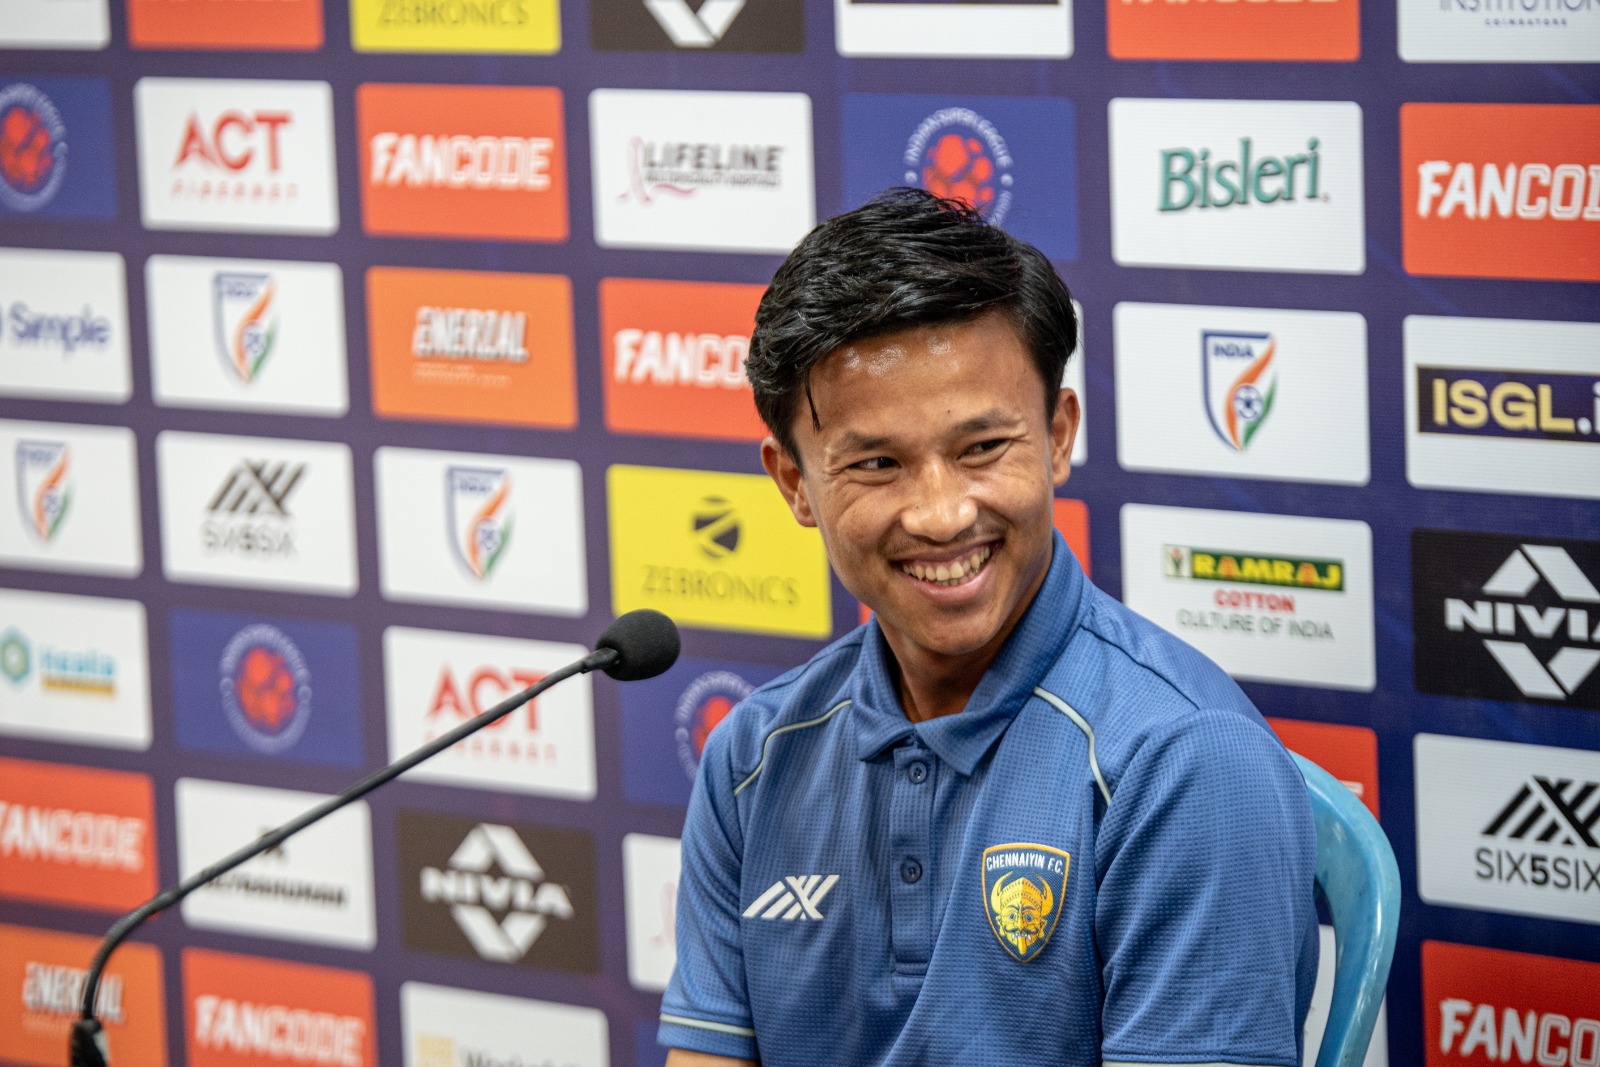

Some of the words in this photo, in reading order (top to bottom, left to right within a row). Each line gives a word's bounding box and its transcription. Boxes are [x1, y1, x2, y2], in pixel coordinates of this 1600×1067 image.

[173, 109, 292, 172] ACT
[370, 132, 553, 190] FANCODE
[614, 328, 752, 388] FANCO
[1213, 341, 1254, 359] INDIA
[640, 564, 802, 607] ZEBRONICS
[1195, 554, 1342, 590] RAMRAJ
[1177, 607, 1253, 633] CULTURE
[1262, 616, 1285, 635] OF
[1289, 619, 1334, 641] INDIA
[1214, 588, 1295, 613] COTTON
[425, 664, 553, 733] ACT
[986, 852, 1045, 871] CHENNAIYIN
[1047, 857, 1064, 875] F.C.
[1475, 846, 1600, 894] SIX5SIX
[419, 866, 574, 921] NIVIA
[25, 964, 124, 1022] ENERAL
[194, 994, 366, 1066] FANCODE
